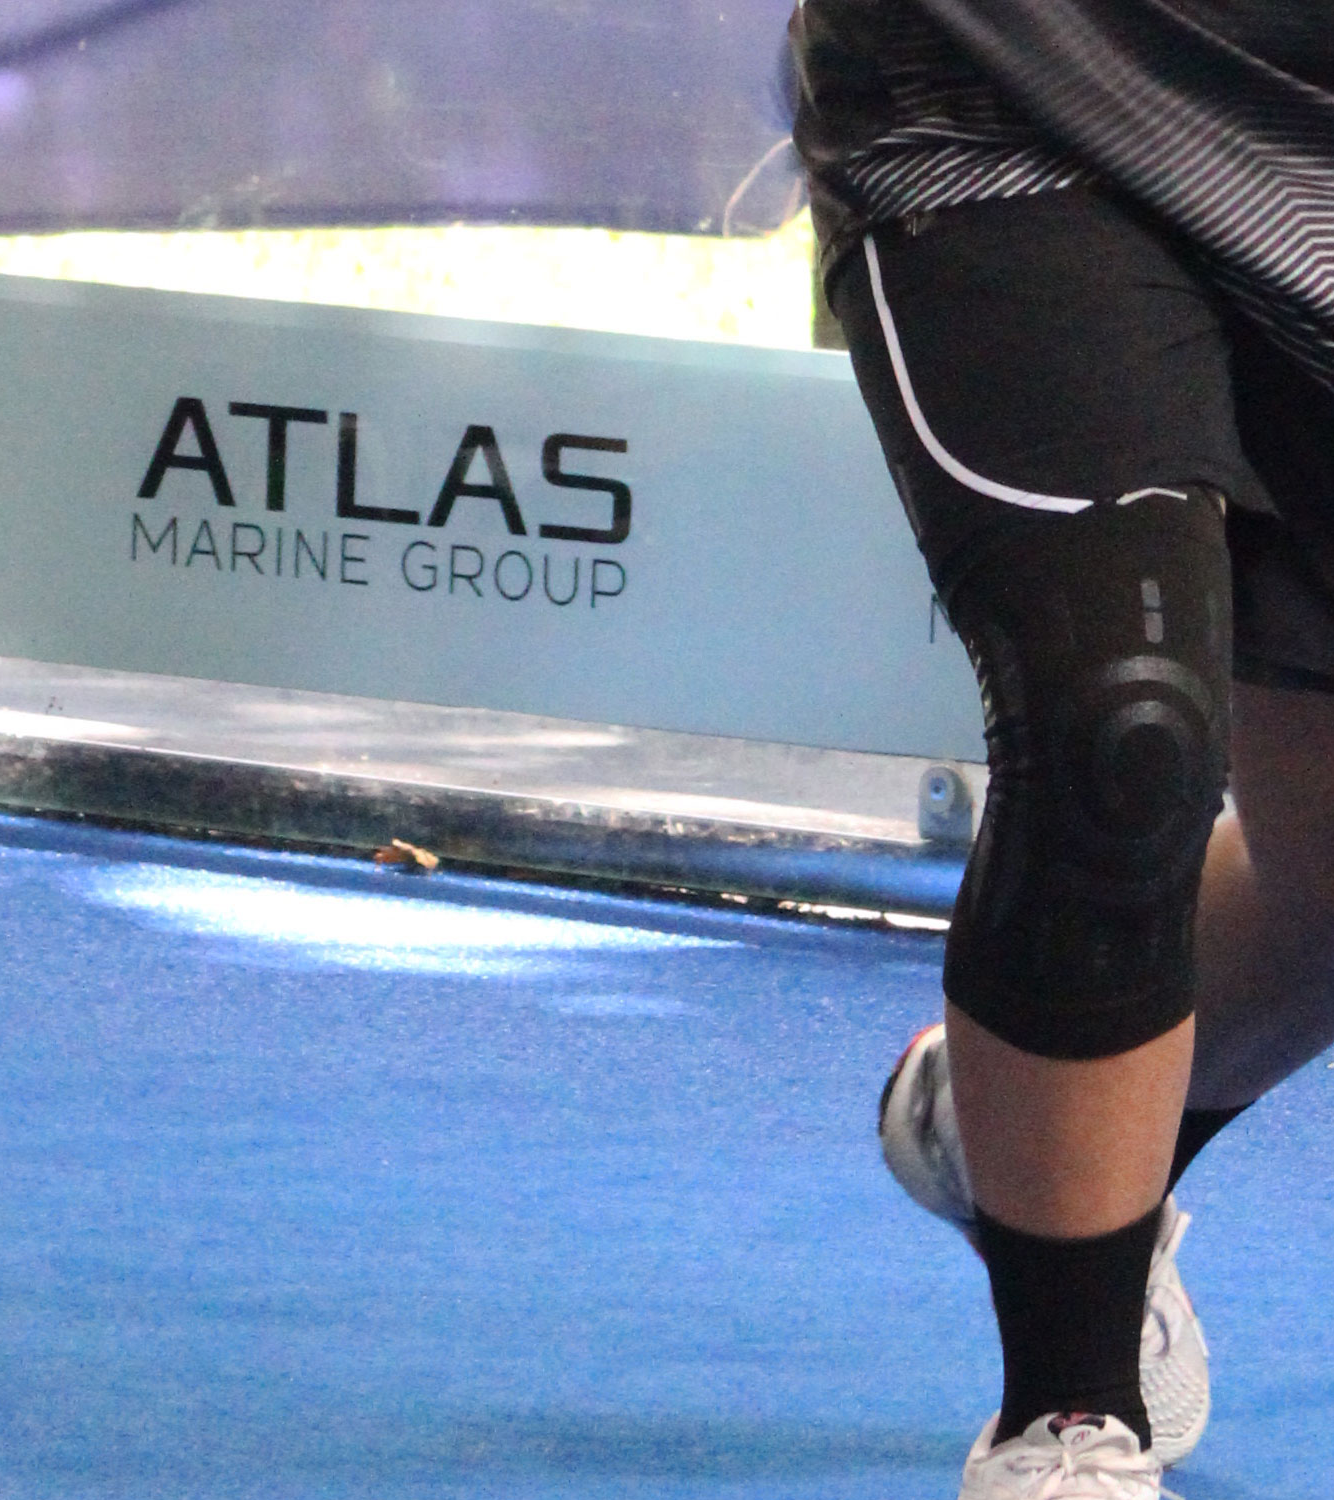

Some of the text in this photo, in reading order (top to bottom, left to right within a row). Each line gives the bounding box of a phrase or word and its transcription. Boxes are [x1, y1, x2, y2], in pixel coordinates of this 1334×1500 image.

[137, 397, 632, 544] ATLAS
[130, 513, 627, 609] MARINE GROUP
